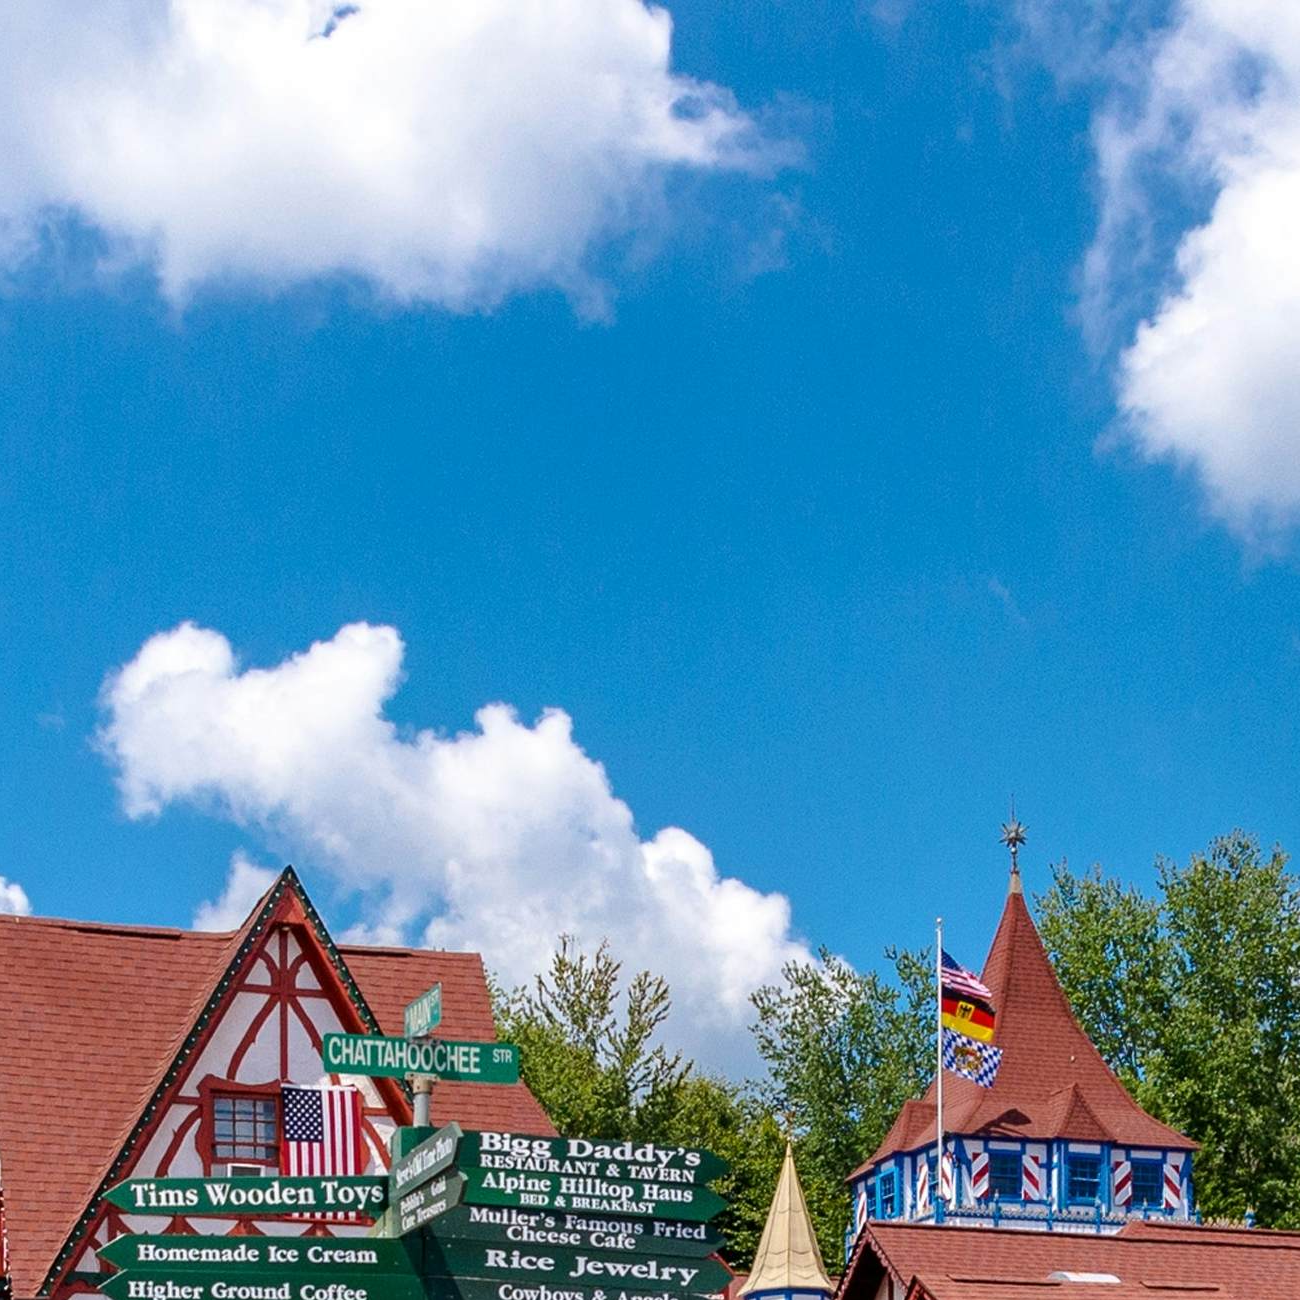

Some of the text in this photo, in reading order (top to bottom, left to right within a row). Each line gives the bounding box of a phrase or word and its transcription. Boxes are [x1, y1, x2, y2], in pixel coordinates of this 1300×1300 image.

[328, 1037, 513, 1074] CHATTAHOOCHEE STR
[480, 1133, 701, 1167] Bigg Daddy's
[480, 1155, 695, 1183] RESTAURANT & TAVERN
[130, 1181, 384, 1210] Tims Wooden Toys
[482, 1172, 693, 1203] Alpine Hilltop Haus
[519, 1193, 656, 1214] BED & BREAKFAST
[469, 1207, 707, 1241] Muller's Famous Fried
[506, 1226, 636, 1249] Cheese Cafe
[137, 1243, 378, 1264] Homemade Ice Cream
[485, 1250, 699, 1286] Rice Jewelry
[211, 1283, 292, 1300] Ground
